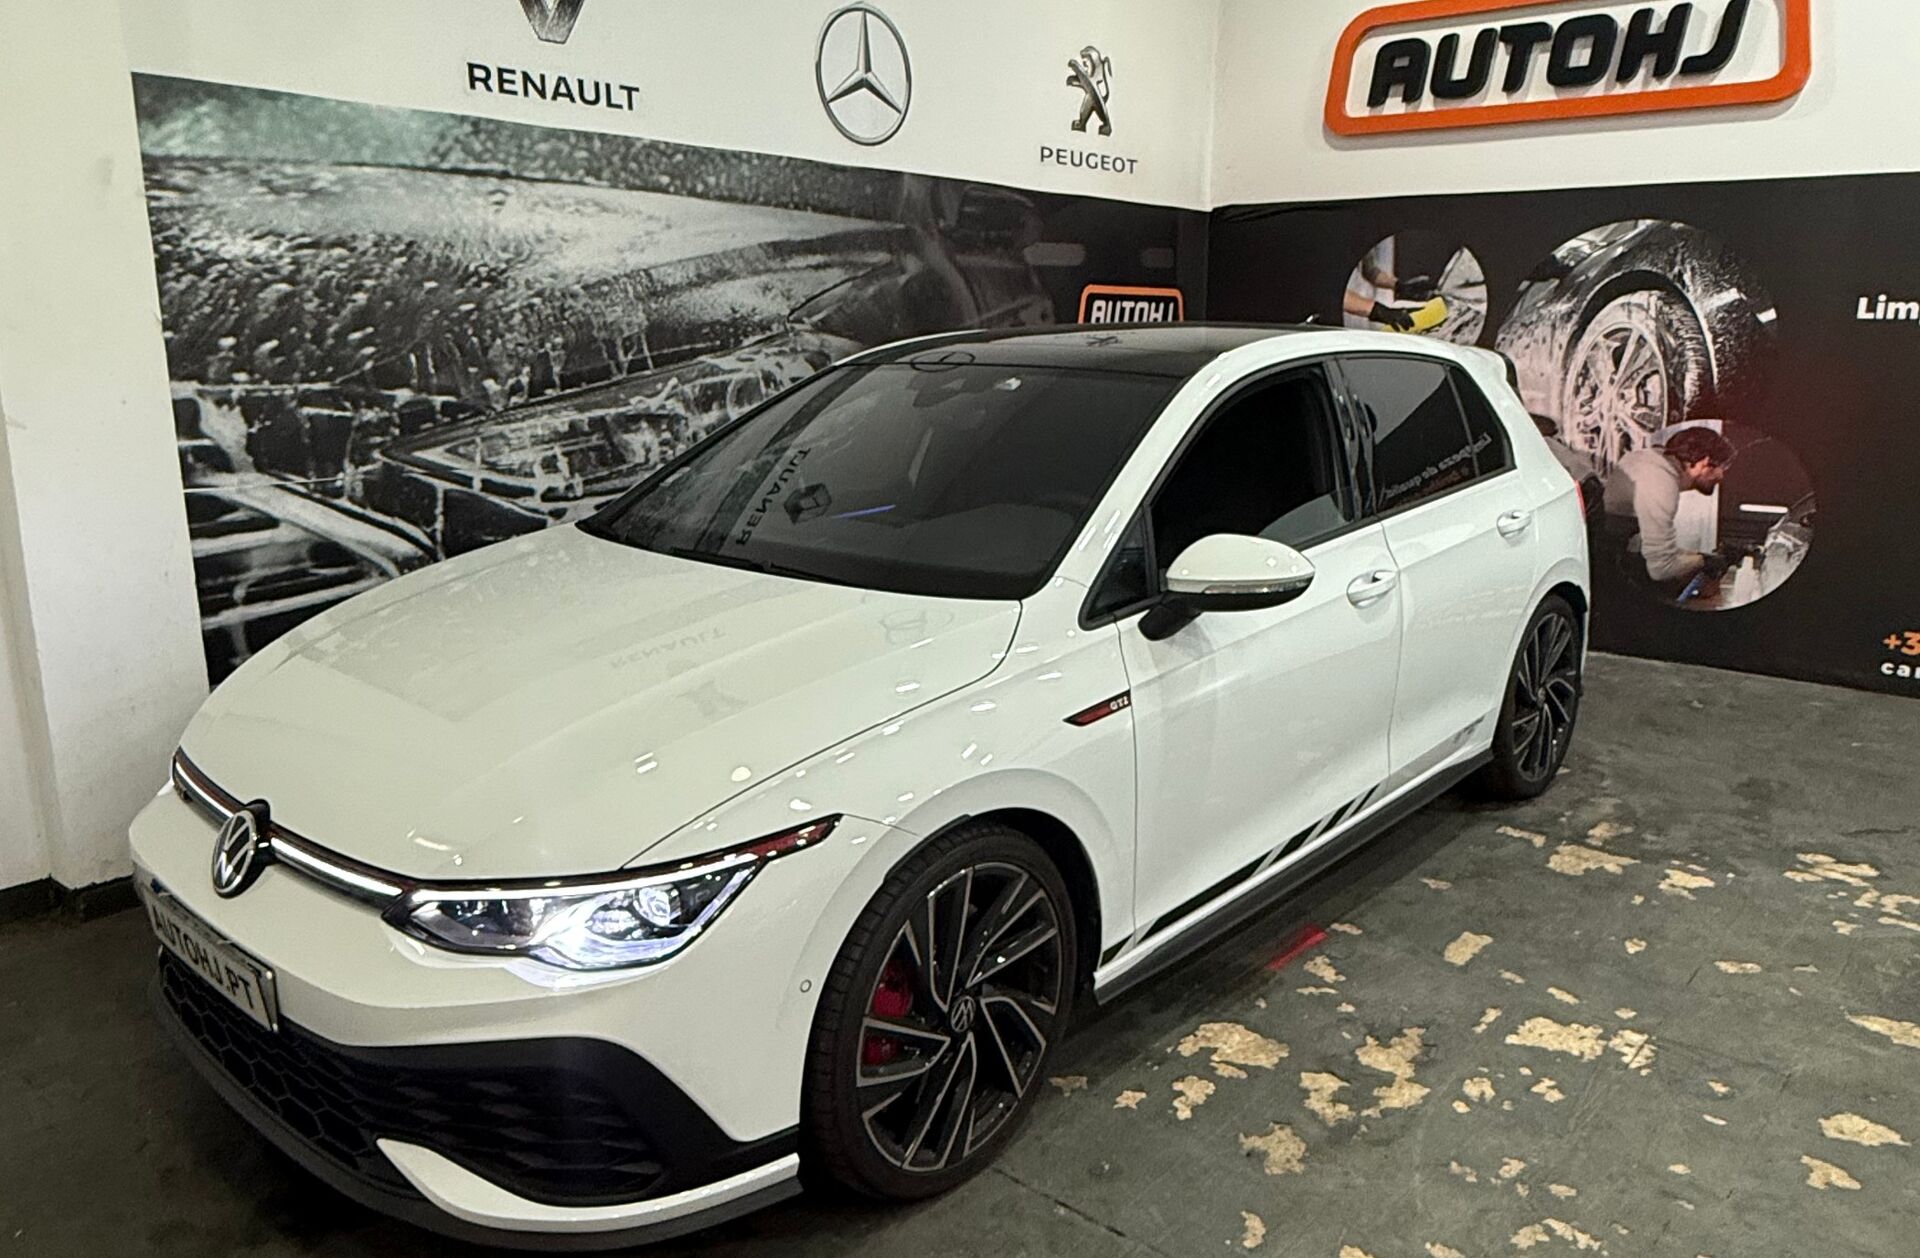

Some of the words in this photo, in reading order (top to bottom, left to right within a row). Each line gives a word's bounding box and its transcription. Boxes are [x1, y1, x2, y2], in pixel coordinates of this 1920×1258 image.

[1366, 0, 1750, 108] AUTOHJ
[467, 62, 640, 111] RENAULT
[1040, 146, 1138, 174] PEUGEOT
[1856, 294, 1920, 326] Lim
[1109, 695, 1129, 711] GTI
